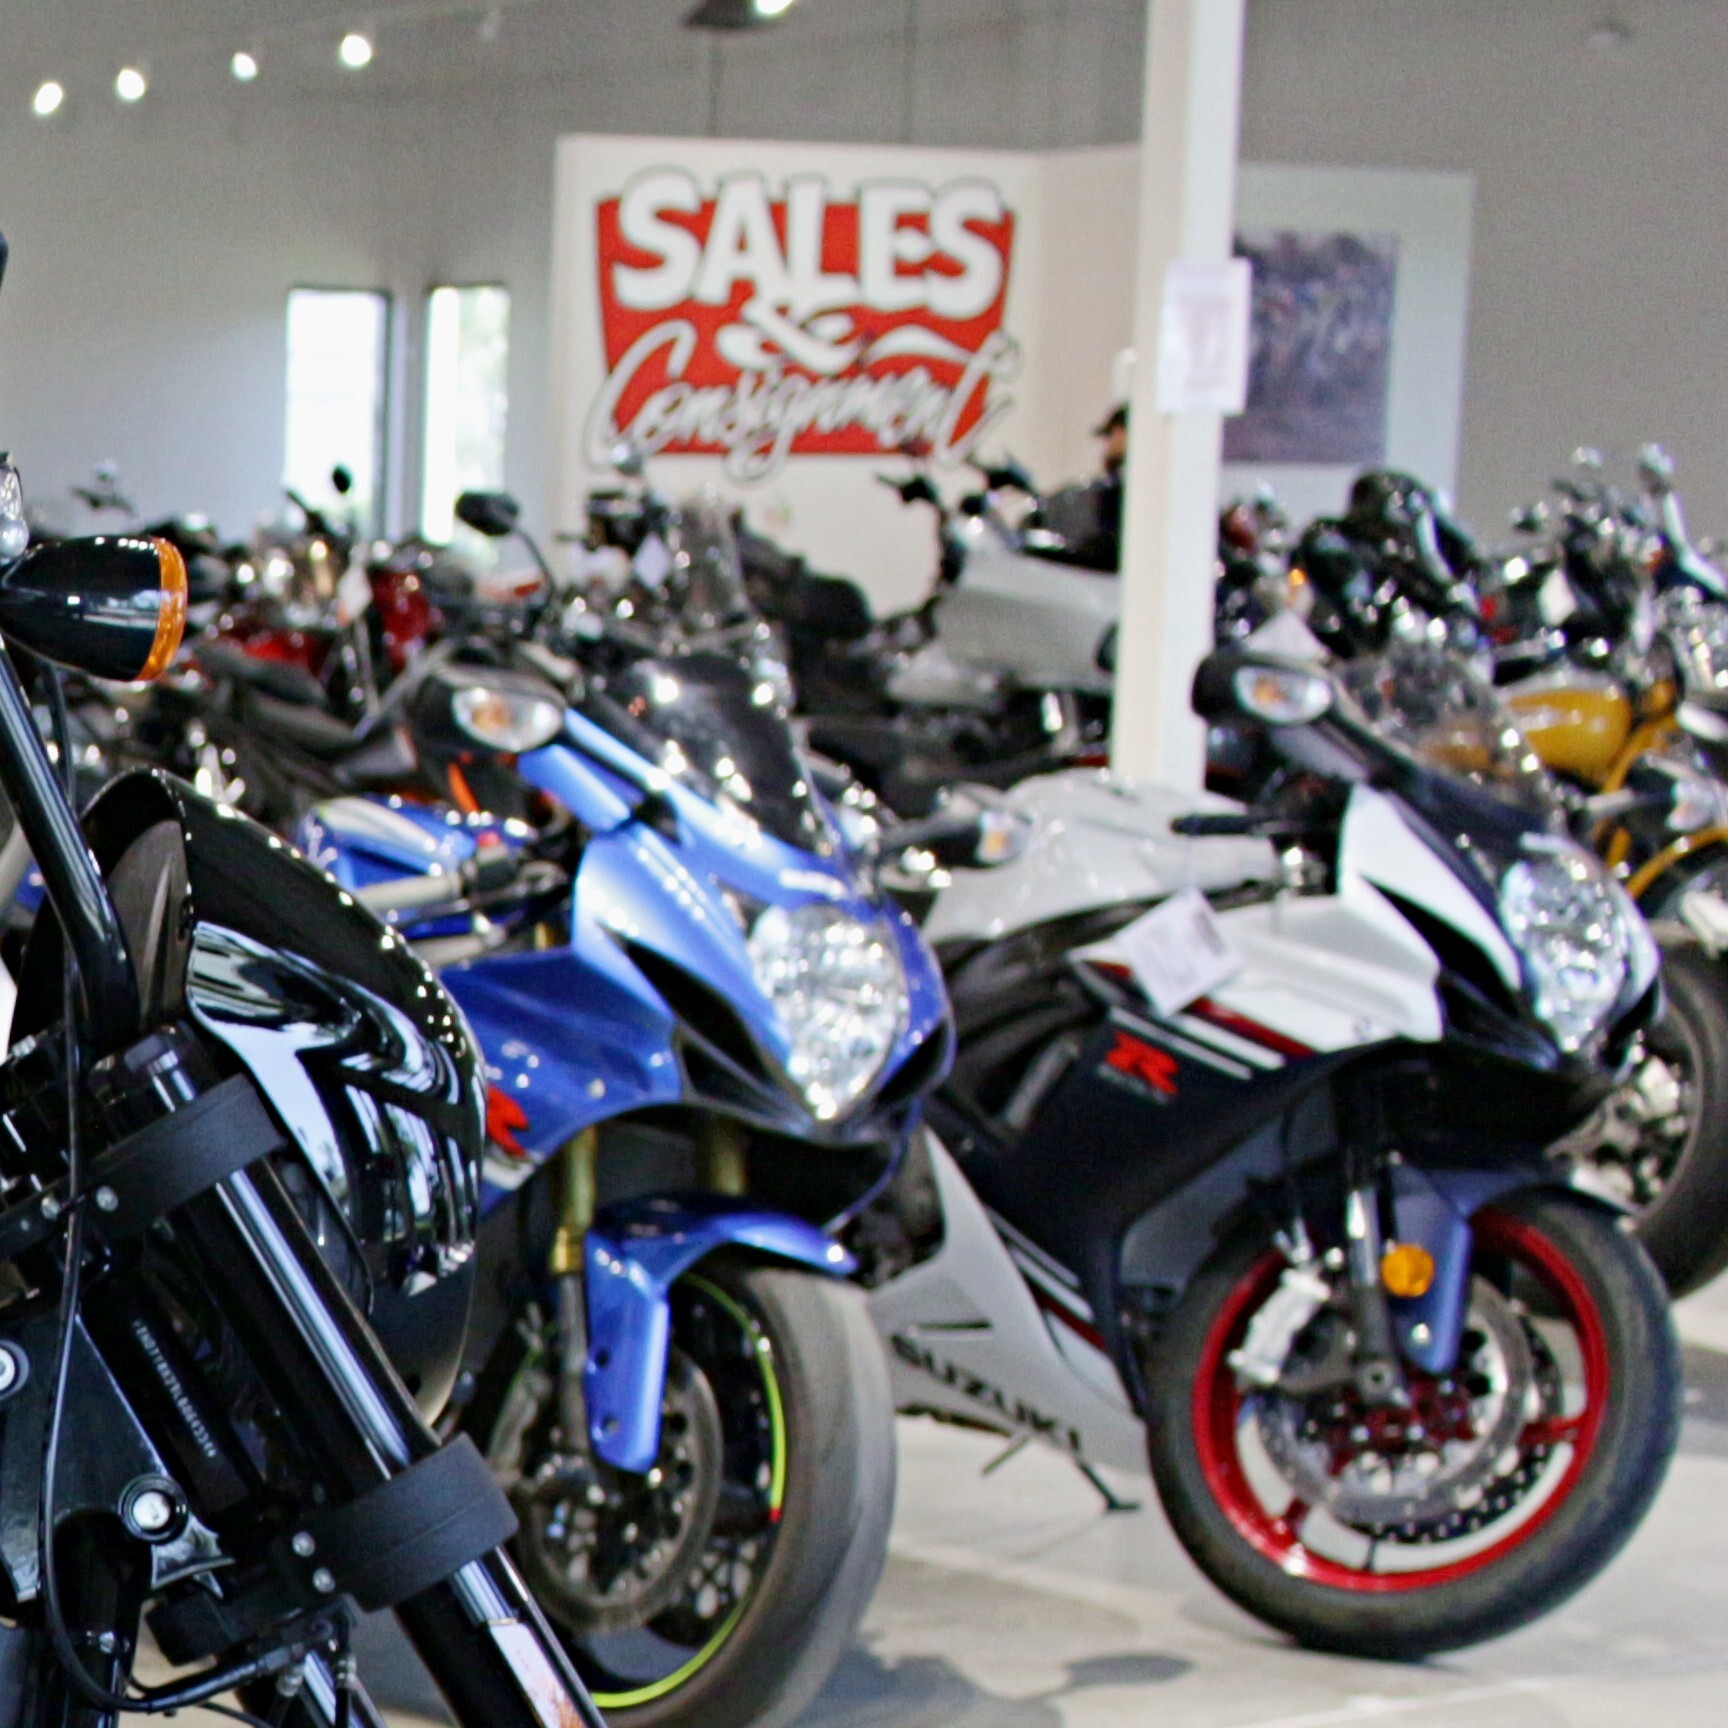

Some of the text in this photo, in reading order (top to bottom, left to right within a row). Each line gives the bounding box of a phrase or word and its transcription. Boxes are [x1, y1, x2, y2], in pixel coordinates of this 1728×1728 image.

[612, 168, 1010, 321] SALES
[585, 320, 1024, 481] Consignment
[890, 1333, 1084, 1453] SUZUKI
